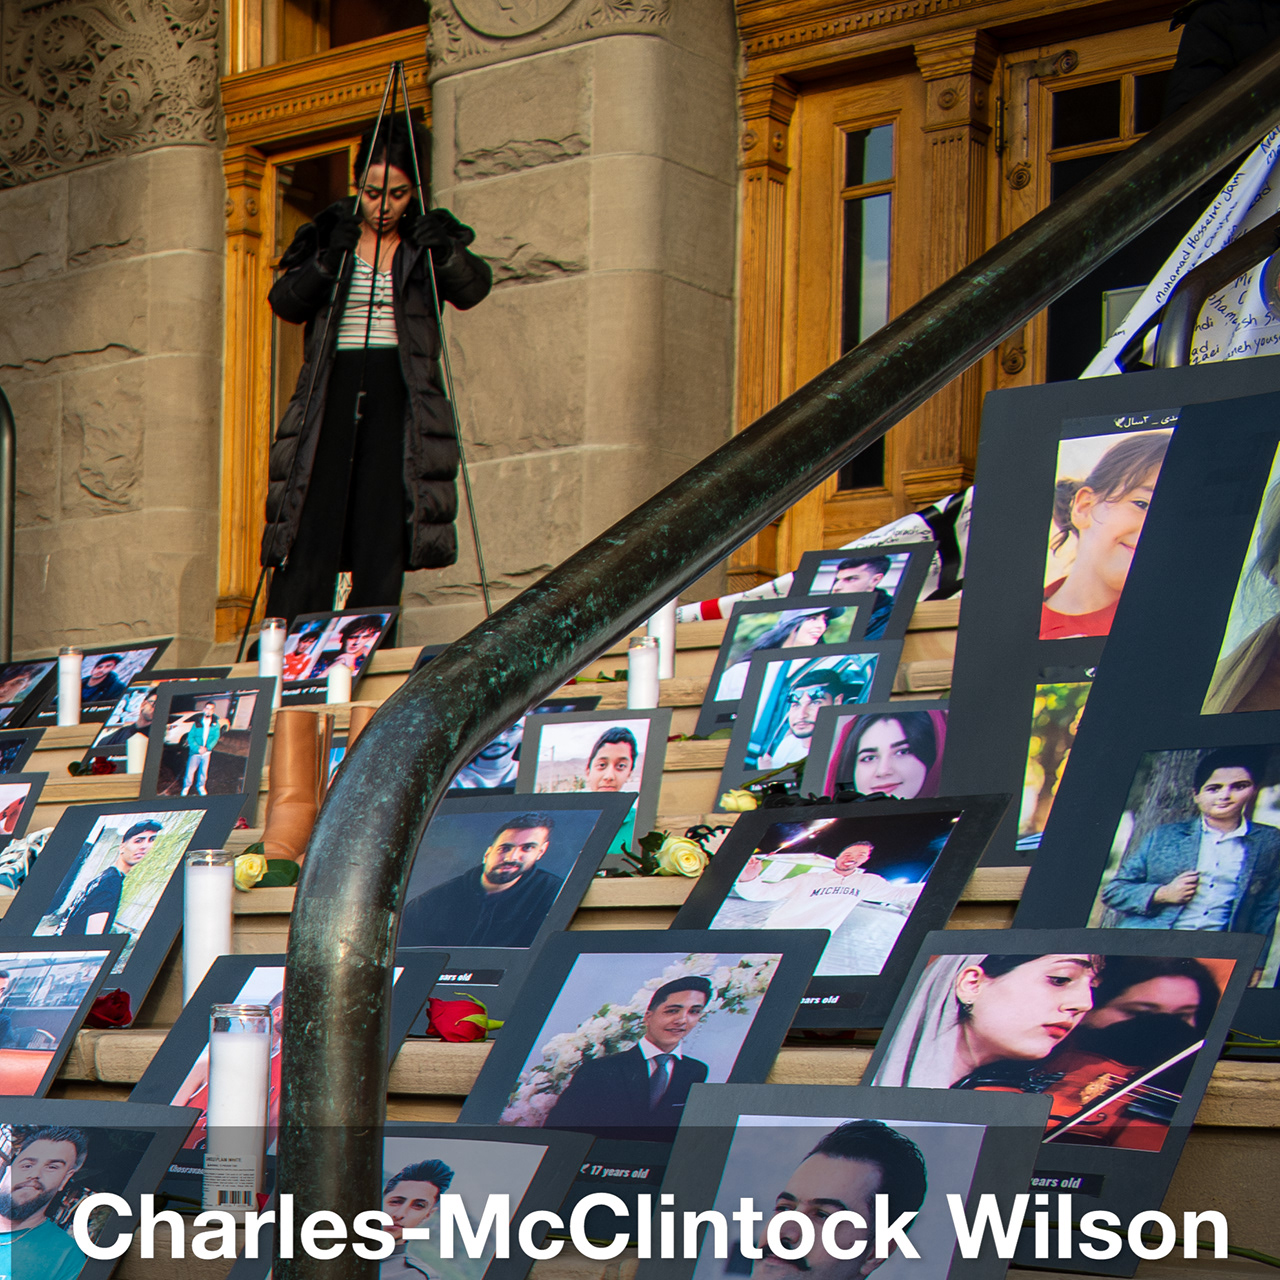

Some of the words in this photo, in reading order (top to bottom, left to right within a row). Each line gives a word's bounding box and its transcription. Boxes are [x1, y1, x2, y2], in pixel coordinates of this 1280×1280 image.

[809, 887, 860, 899] MICHIGAN
[438, 973, 456, 981] ears
[457, 972, 473, 981] old
[822, 995, 839, 1004] old
[590, 1164, 602, 1176] 17
[602, 1166, 629, 1179] years
[631, 1167, 649, 1179] old
[1031, 1177, 1059, 1188] ears
[1060, 1177, 1081, 1189] old
